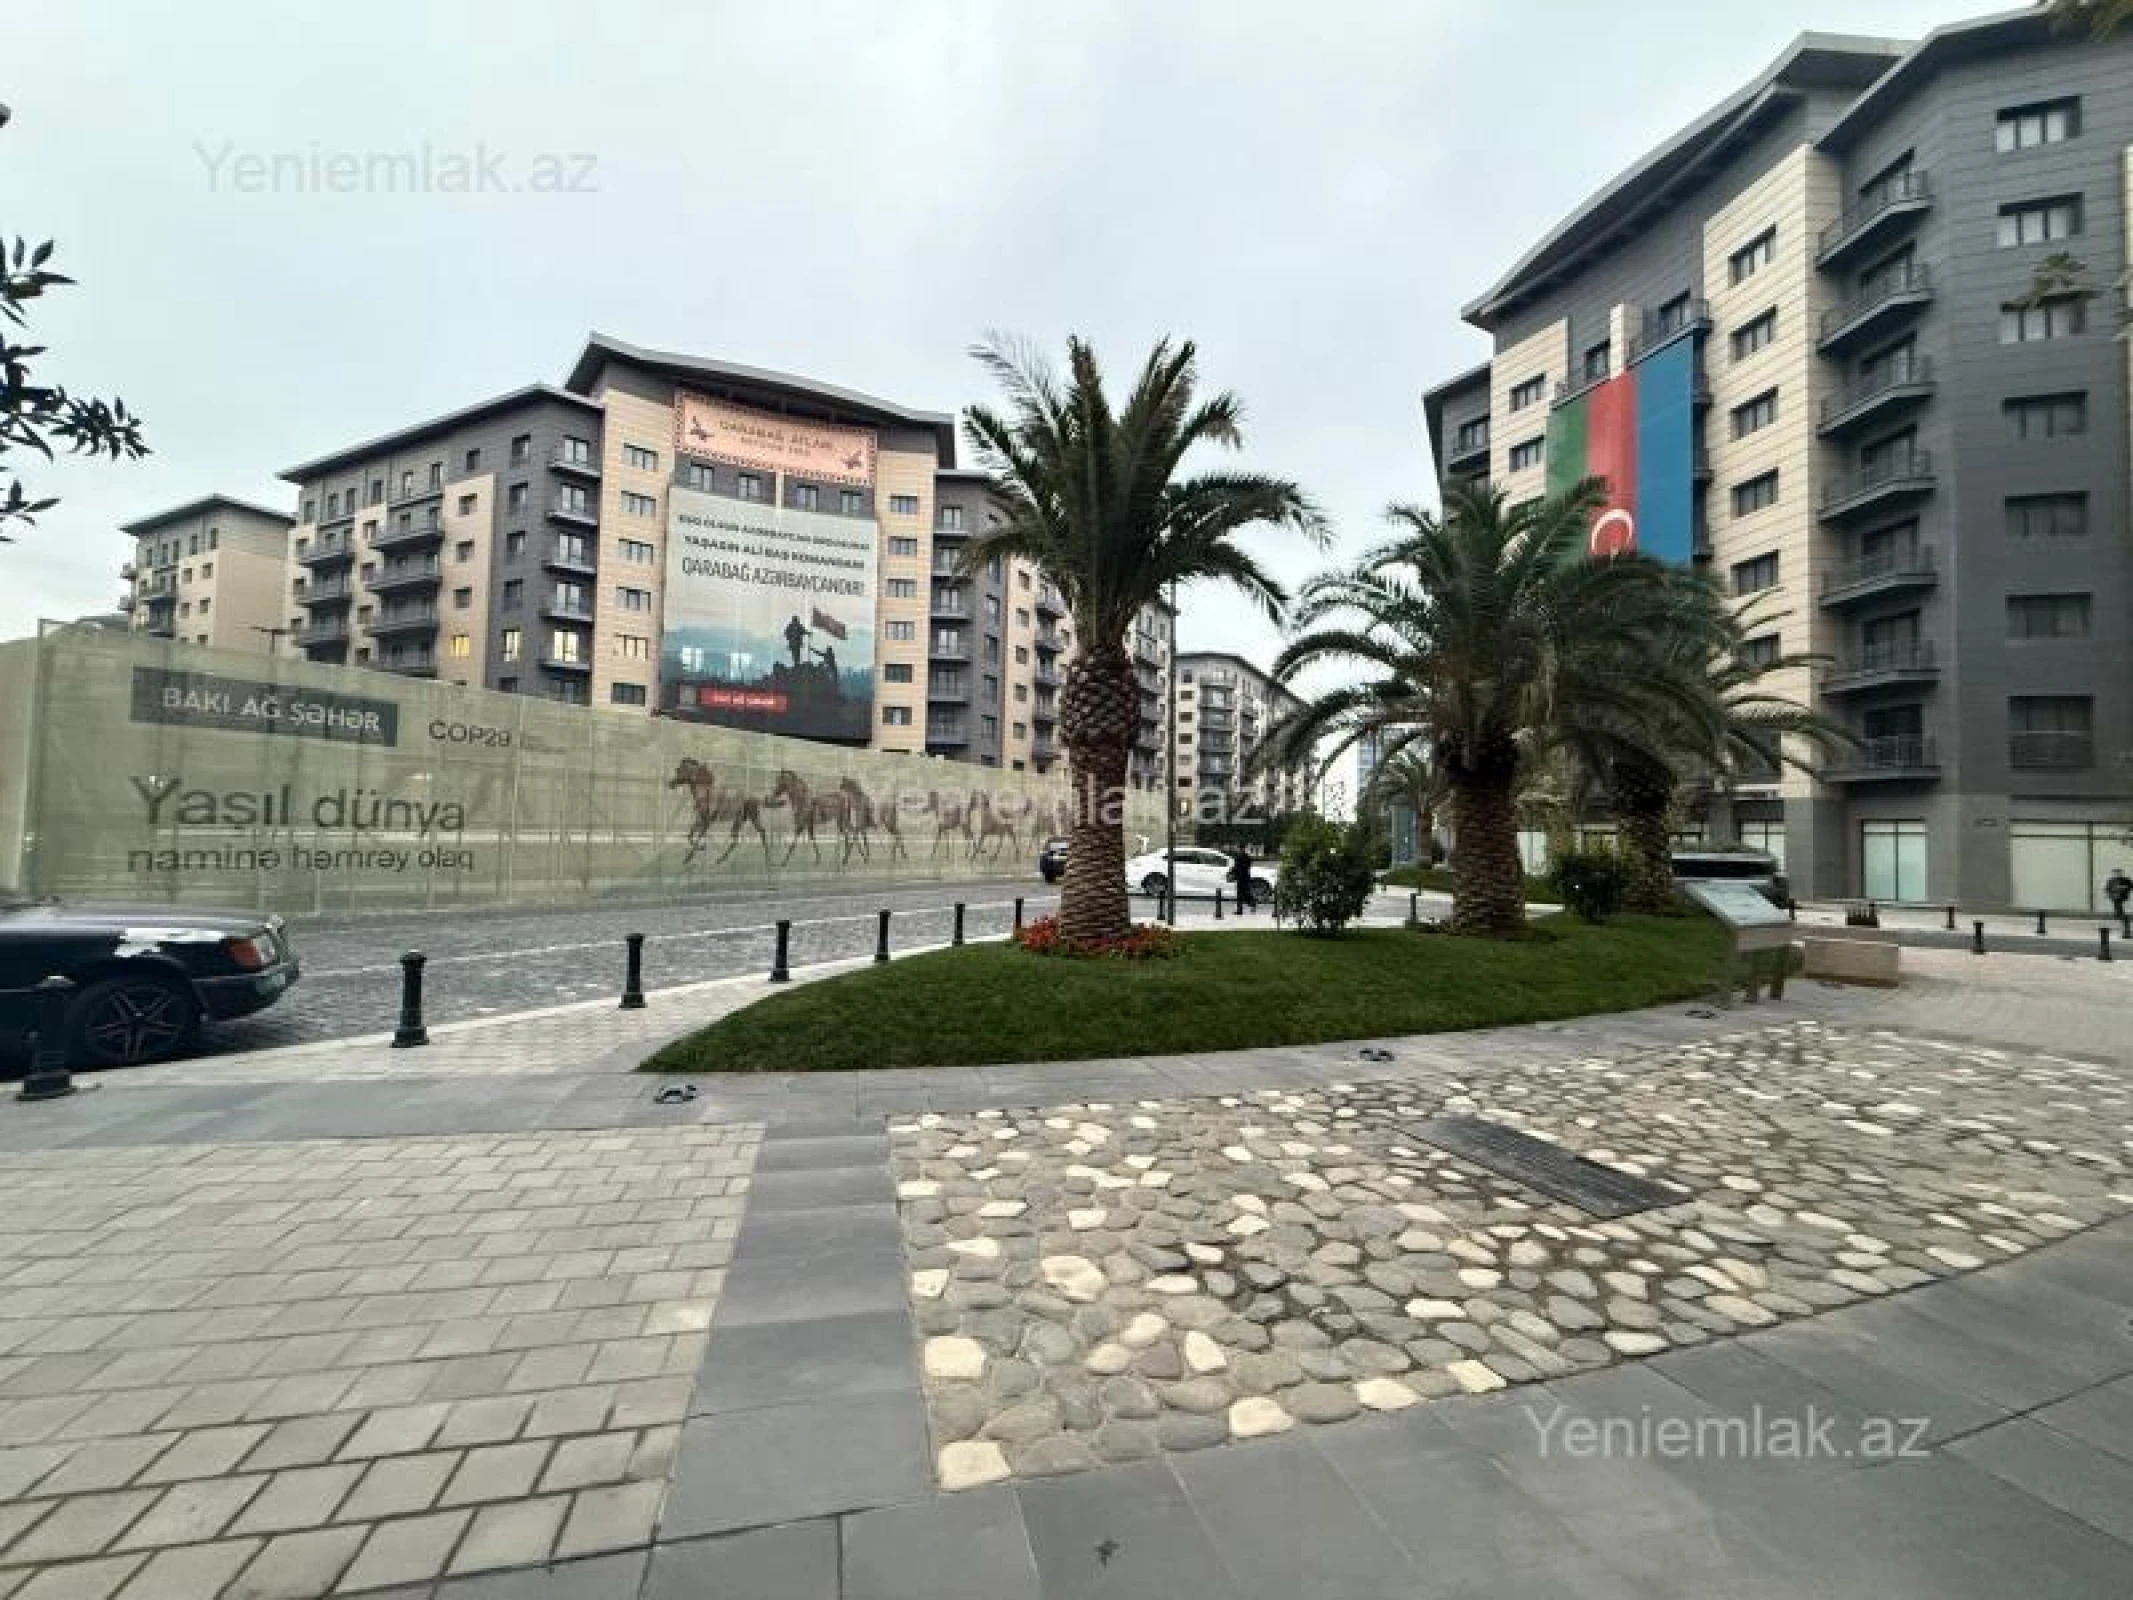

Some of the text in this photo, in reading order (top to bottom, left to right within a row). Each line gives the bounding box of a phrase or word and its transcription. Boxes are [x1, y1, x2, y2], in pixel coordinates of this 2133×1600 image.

[161, 686, 230, 714] BAKI
[239, 696, 281, 719] AĞ
[428, 719, 510, 748] COP29
[130, 775, 466, 834] Yaşıl dünya
[128, 845, 474, 873] naminə həmrəy olaq
